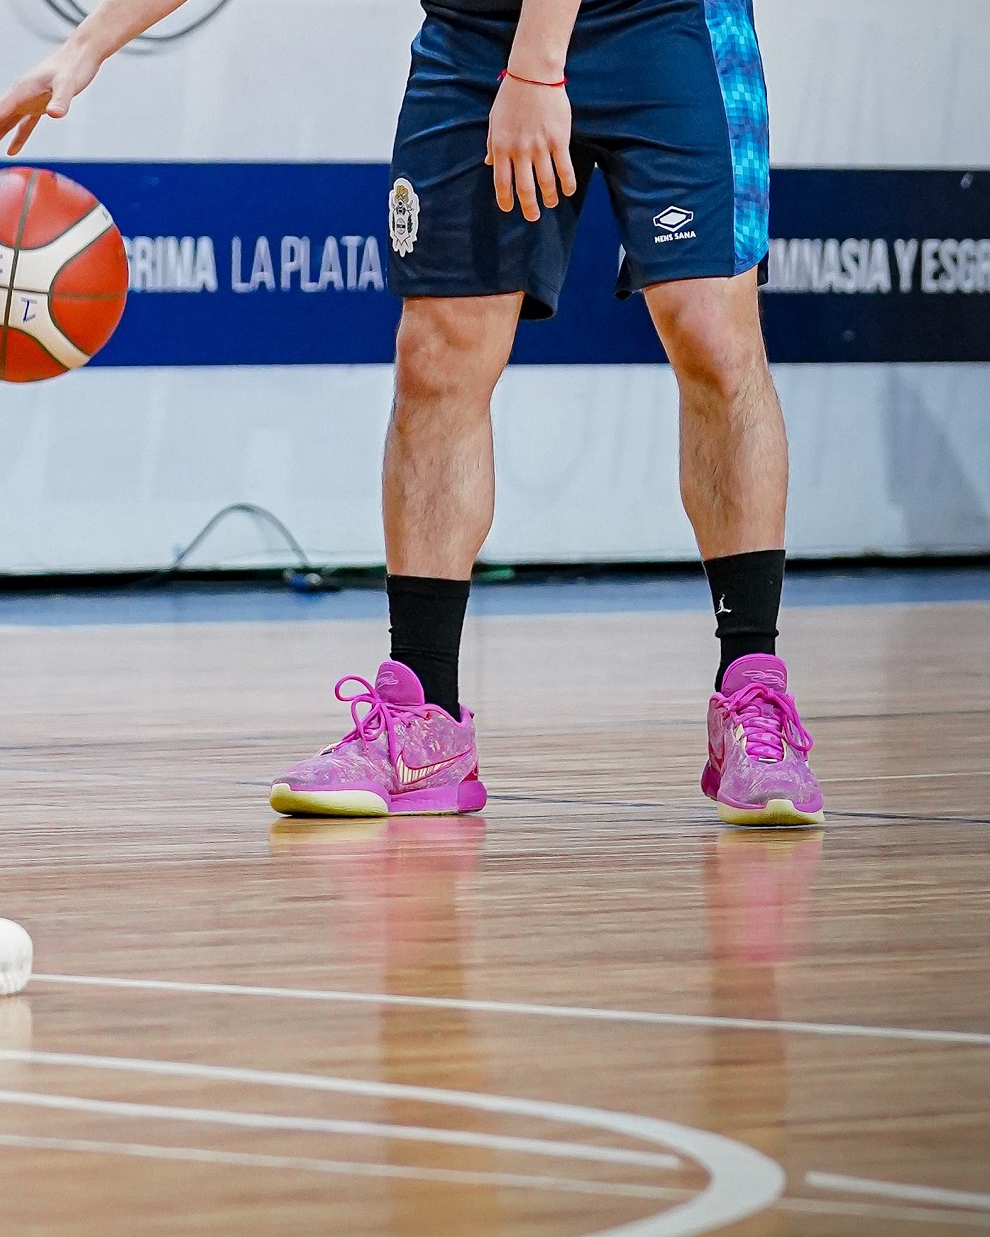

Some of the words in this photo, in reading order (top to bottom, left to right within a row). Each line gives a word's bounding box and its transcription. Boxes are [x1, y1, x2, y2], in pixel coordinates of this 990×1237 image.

[674, 230, 697, 240] SANA
[122, 235, 218, 293] RIMA
[231, 235, 276, 293] LA
[280, 235, 384, 293] PLATA
[893, 237, 919, 294] Y
